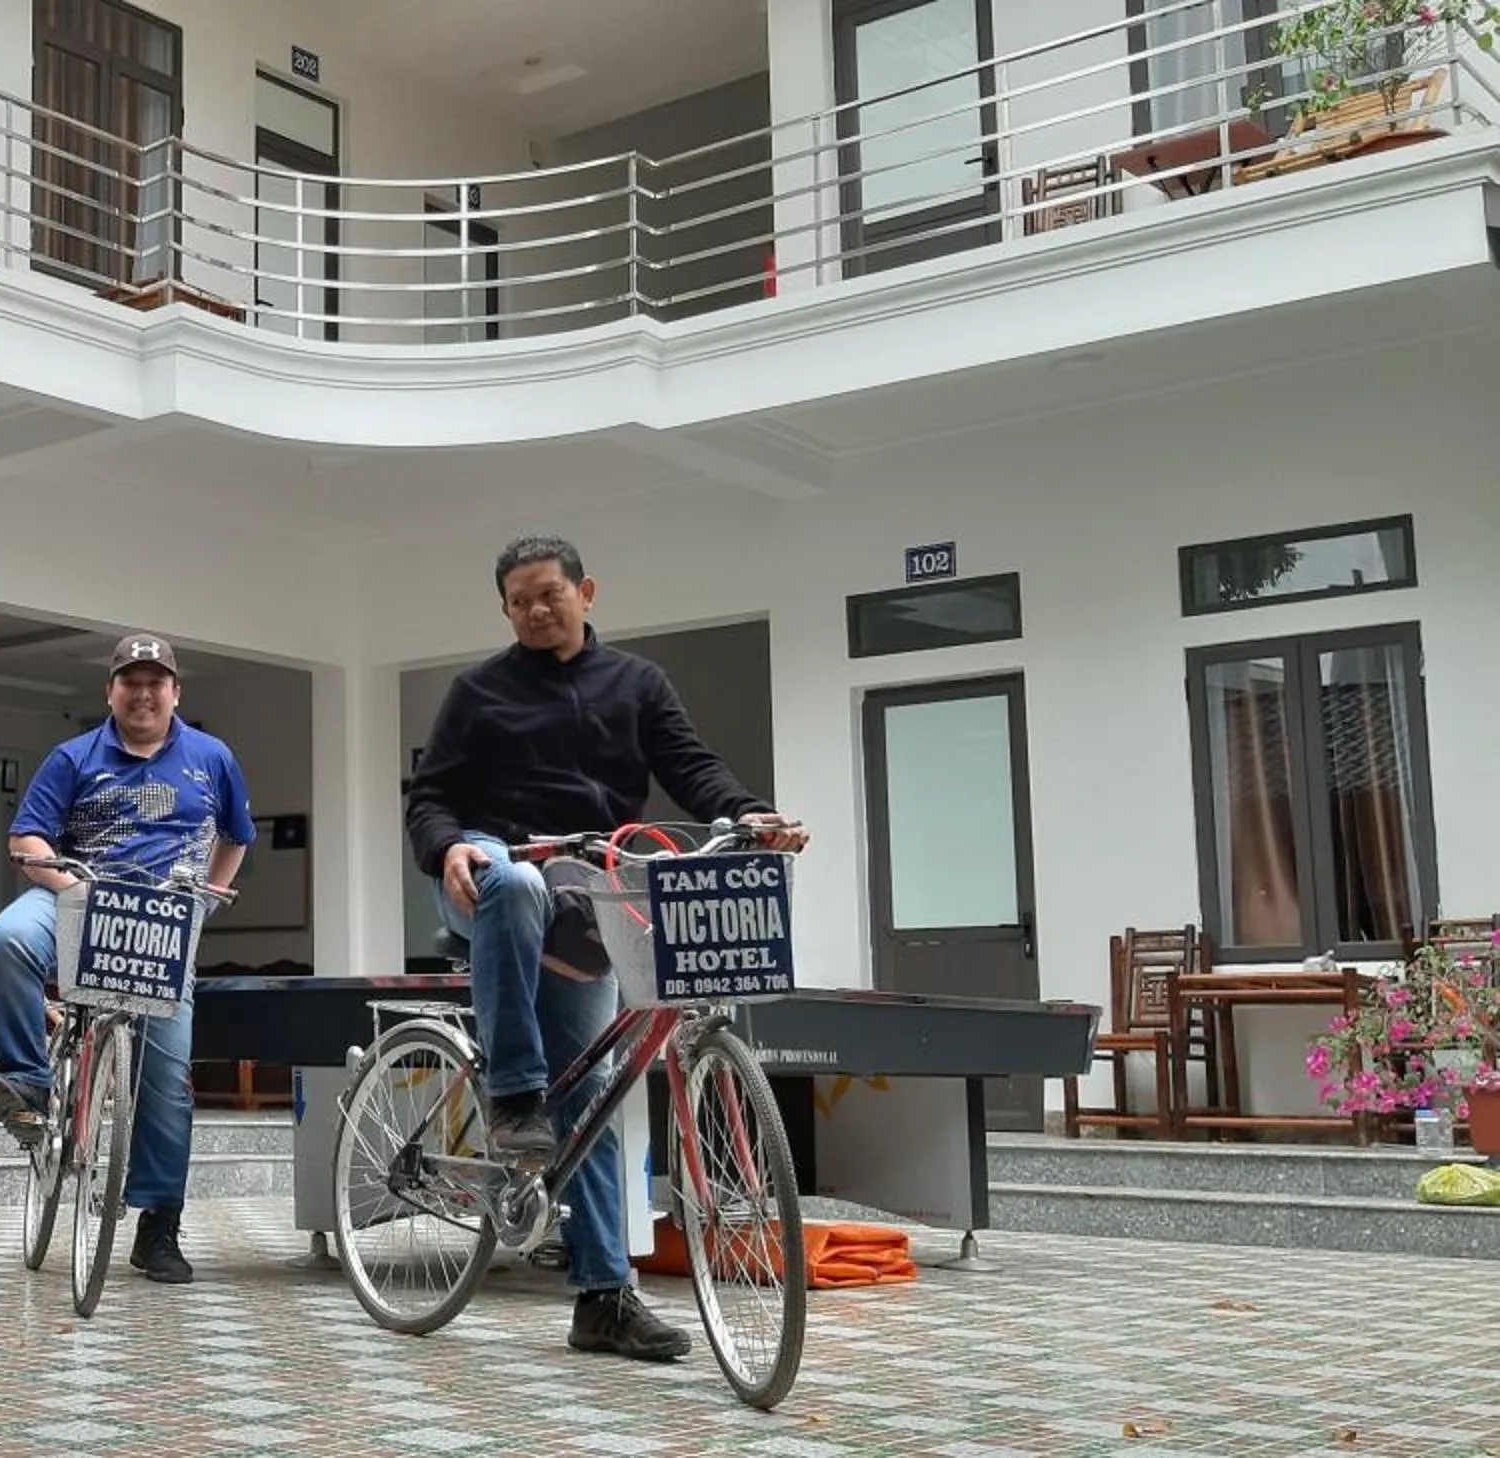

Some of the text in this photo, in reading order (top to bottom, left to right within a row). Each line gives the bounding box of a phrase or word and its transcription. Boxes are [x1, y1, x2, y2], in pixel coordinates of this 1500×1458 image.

[295, 52, 317, 75] 202
[911, 551, 949, 575] 102
[658, 858, 779, 893] TAM CỐC
[94, 890, 188, 920] TAM CỐC
[659, 896, 785, 945] VICTORIA
[89, 912, 181, 961] VICTORIA
[92, 953, 170, 981] HOTEL
[675, 947, 777, 973] HOTEL
[695, 977, 731, 994] 0942
[733, 975, 761, 991] 364
[764, 973, 789, 990] 706
